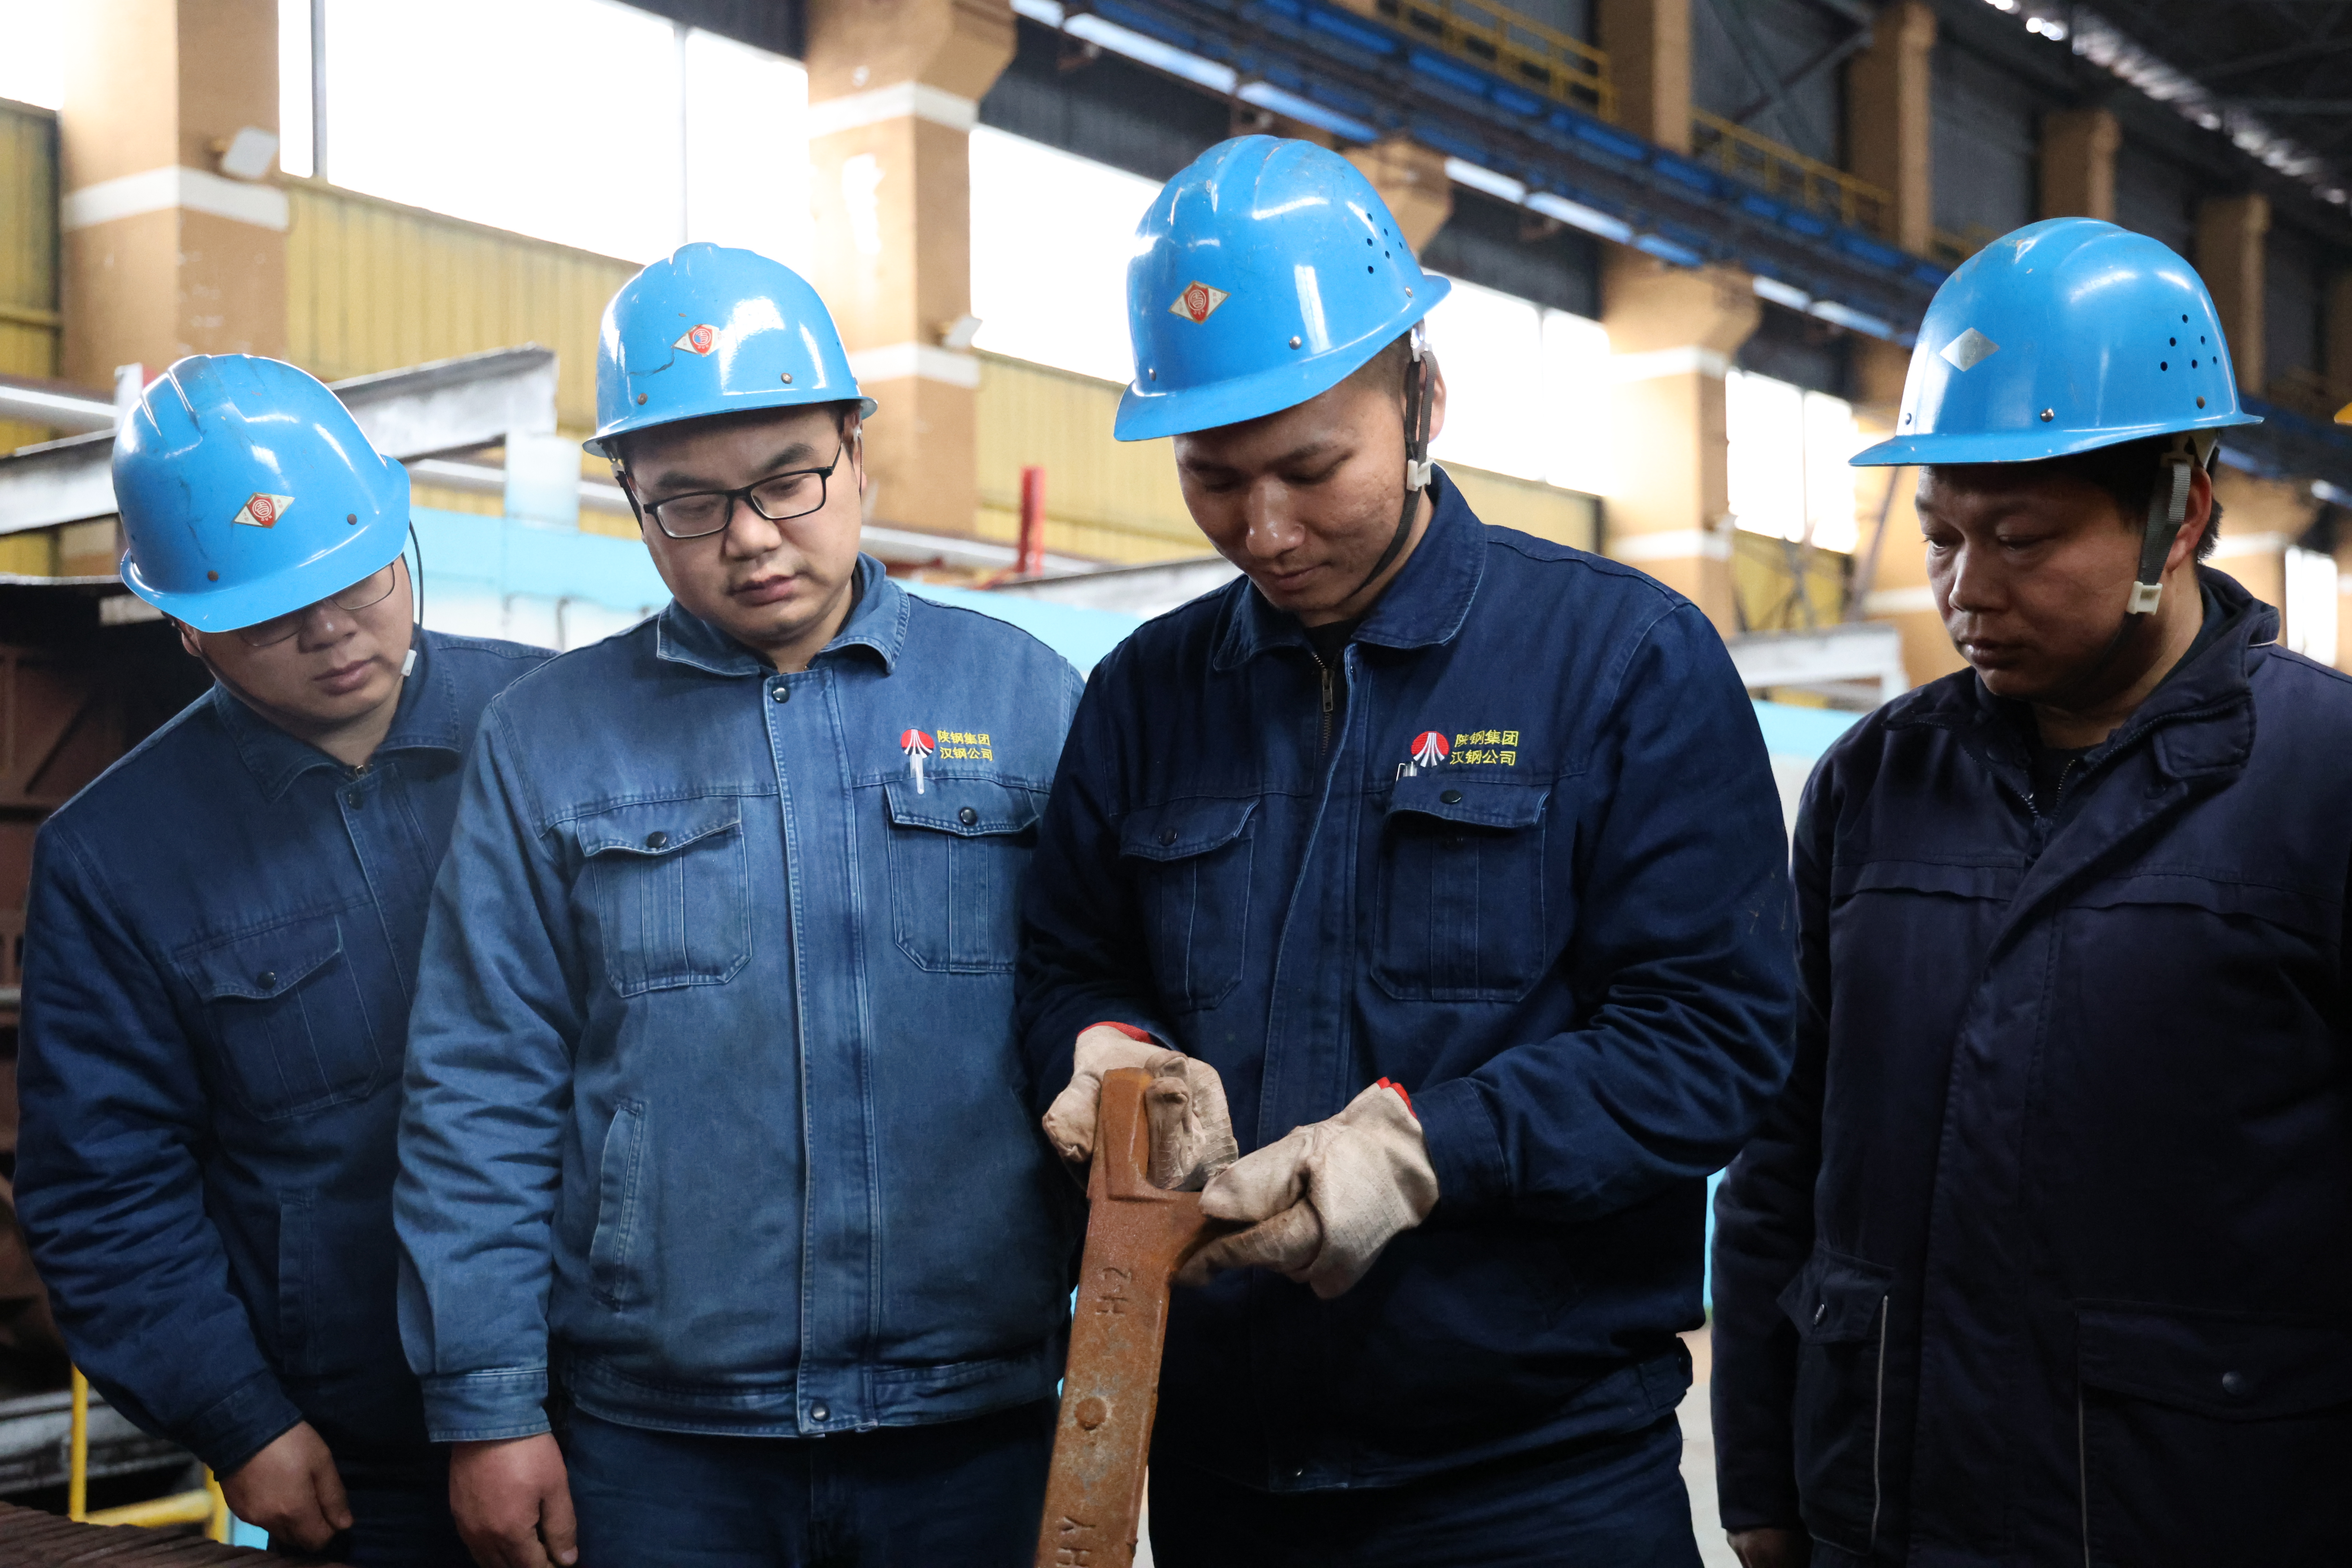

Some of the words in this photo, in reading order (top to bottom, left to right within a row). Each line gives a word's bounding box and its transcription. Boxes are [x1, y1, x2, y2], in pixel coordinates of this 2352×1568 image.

[936, 730, 991, 746] 陕钢集团
[1454, 730, 1519, 748] 陕钢集团
[940, 746, 993, 761] 汉钢公司
[1450, 749, 1516, 766] 汉钢公司
